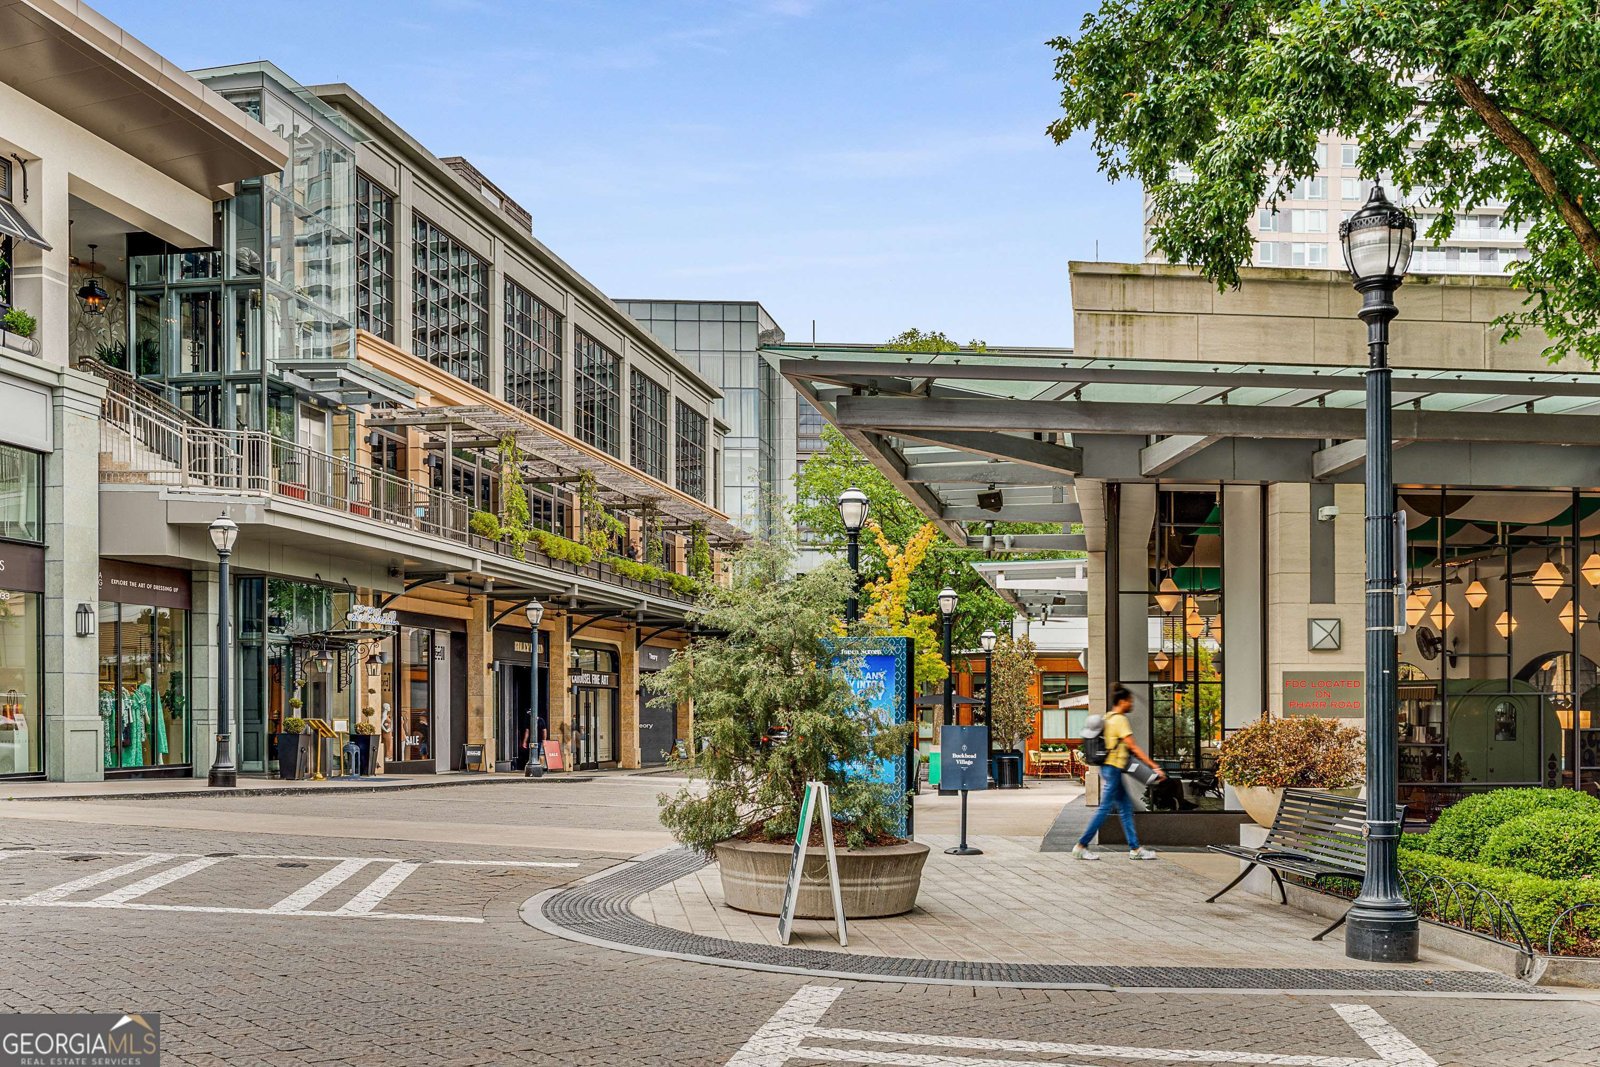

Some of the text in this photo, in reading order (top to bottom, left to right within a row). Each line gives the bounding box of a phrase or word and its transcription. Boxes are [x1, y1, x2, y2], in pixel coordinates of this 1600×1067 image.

[153, 584, 173, 592] DRESSING
[572, 674, 591, 684] CAROUSEL
[592, 674, 600, 684] FINE
[866, 672, 886, 680] ANY
[1285, 680, 1360, 688] FDC LOCATED
[1316, 690, 1332, 698] ON
[1288, 701, 1361, 709] PHARR ROAD
[405, 735, 419, 746] SALE
